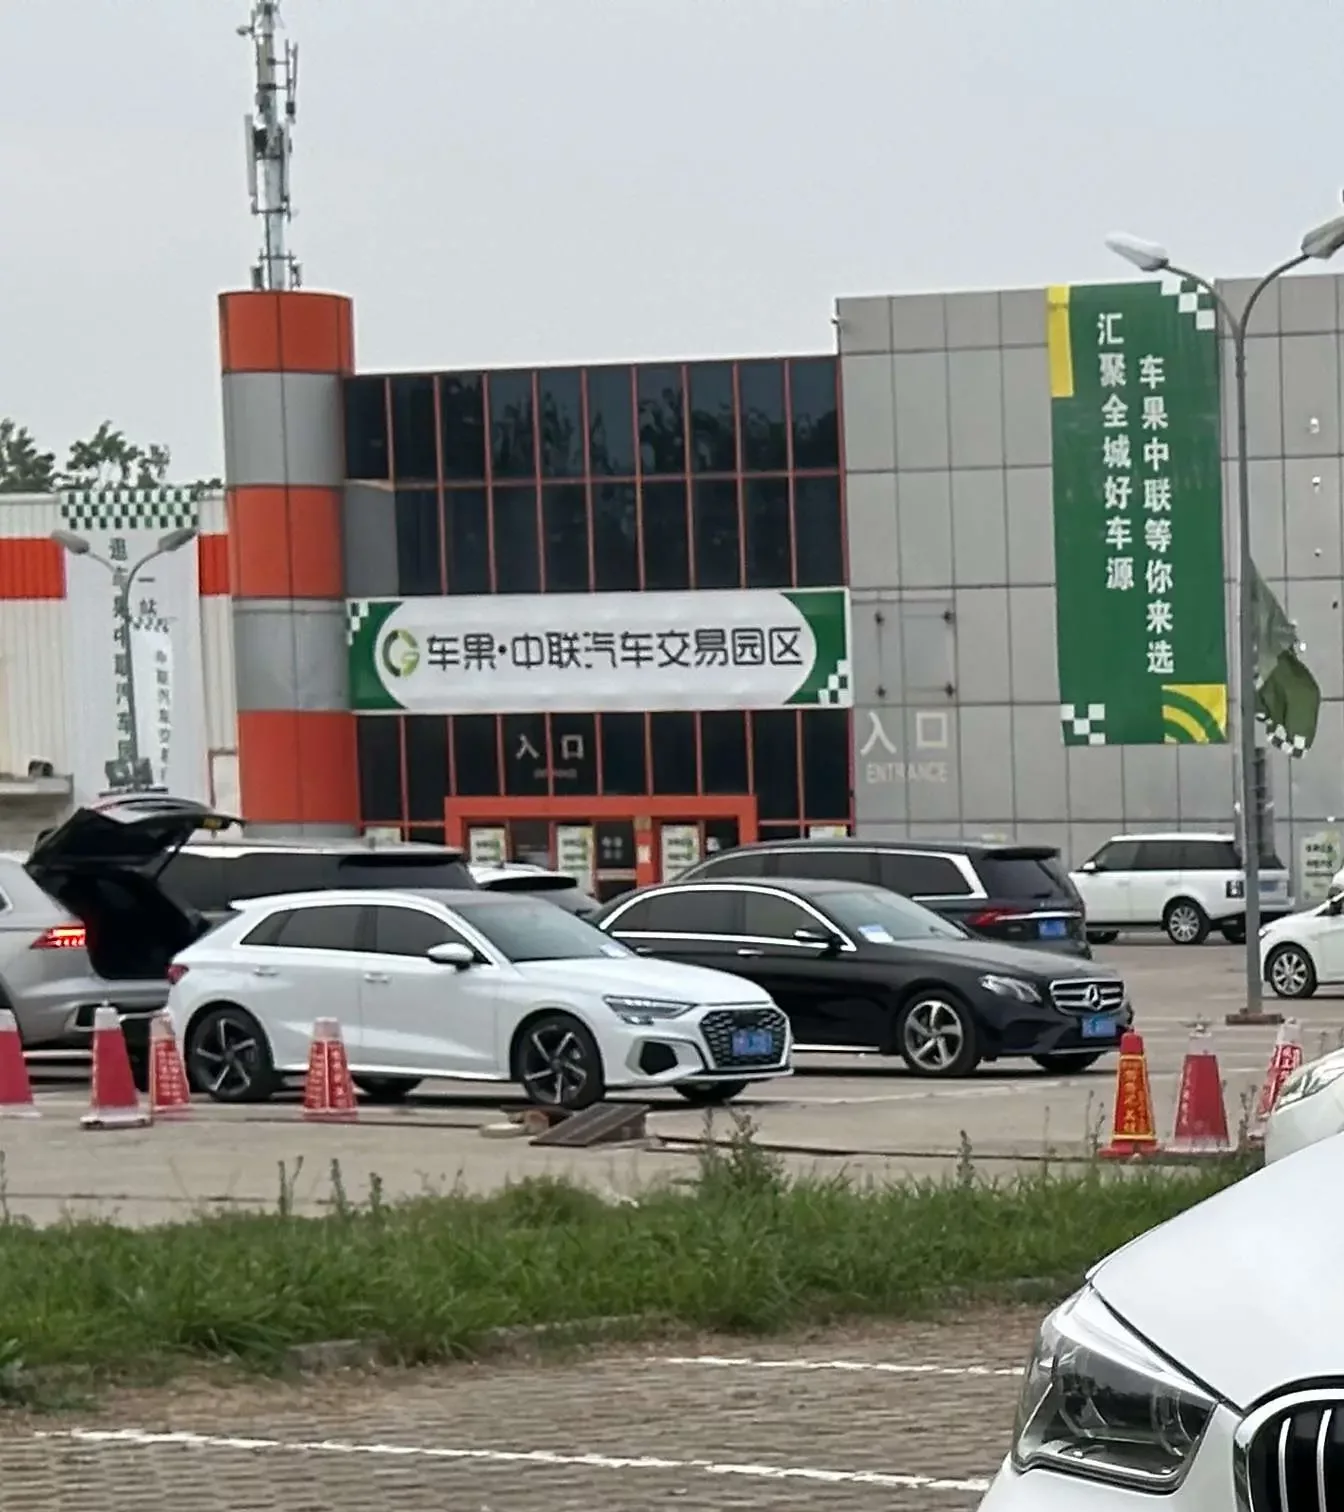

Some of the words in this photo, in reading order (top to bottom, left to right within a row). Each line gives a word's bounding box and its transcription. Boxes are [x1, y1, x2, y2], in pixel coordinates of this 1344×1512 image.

[1097, 312, 1134, 591] 汇聚全城好车源
[1139, 355, 1174, 675] 车果中联等你来选
[427, 627, 803, 671] 车果·中联汽车交易园区
[515, 733, 584, 760] 入口
[860, 711, 947, 756] 入口
